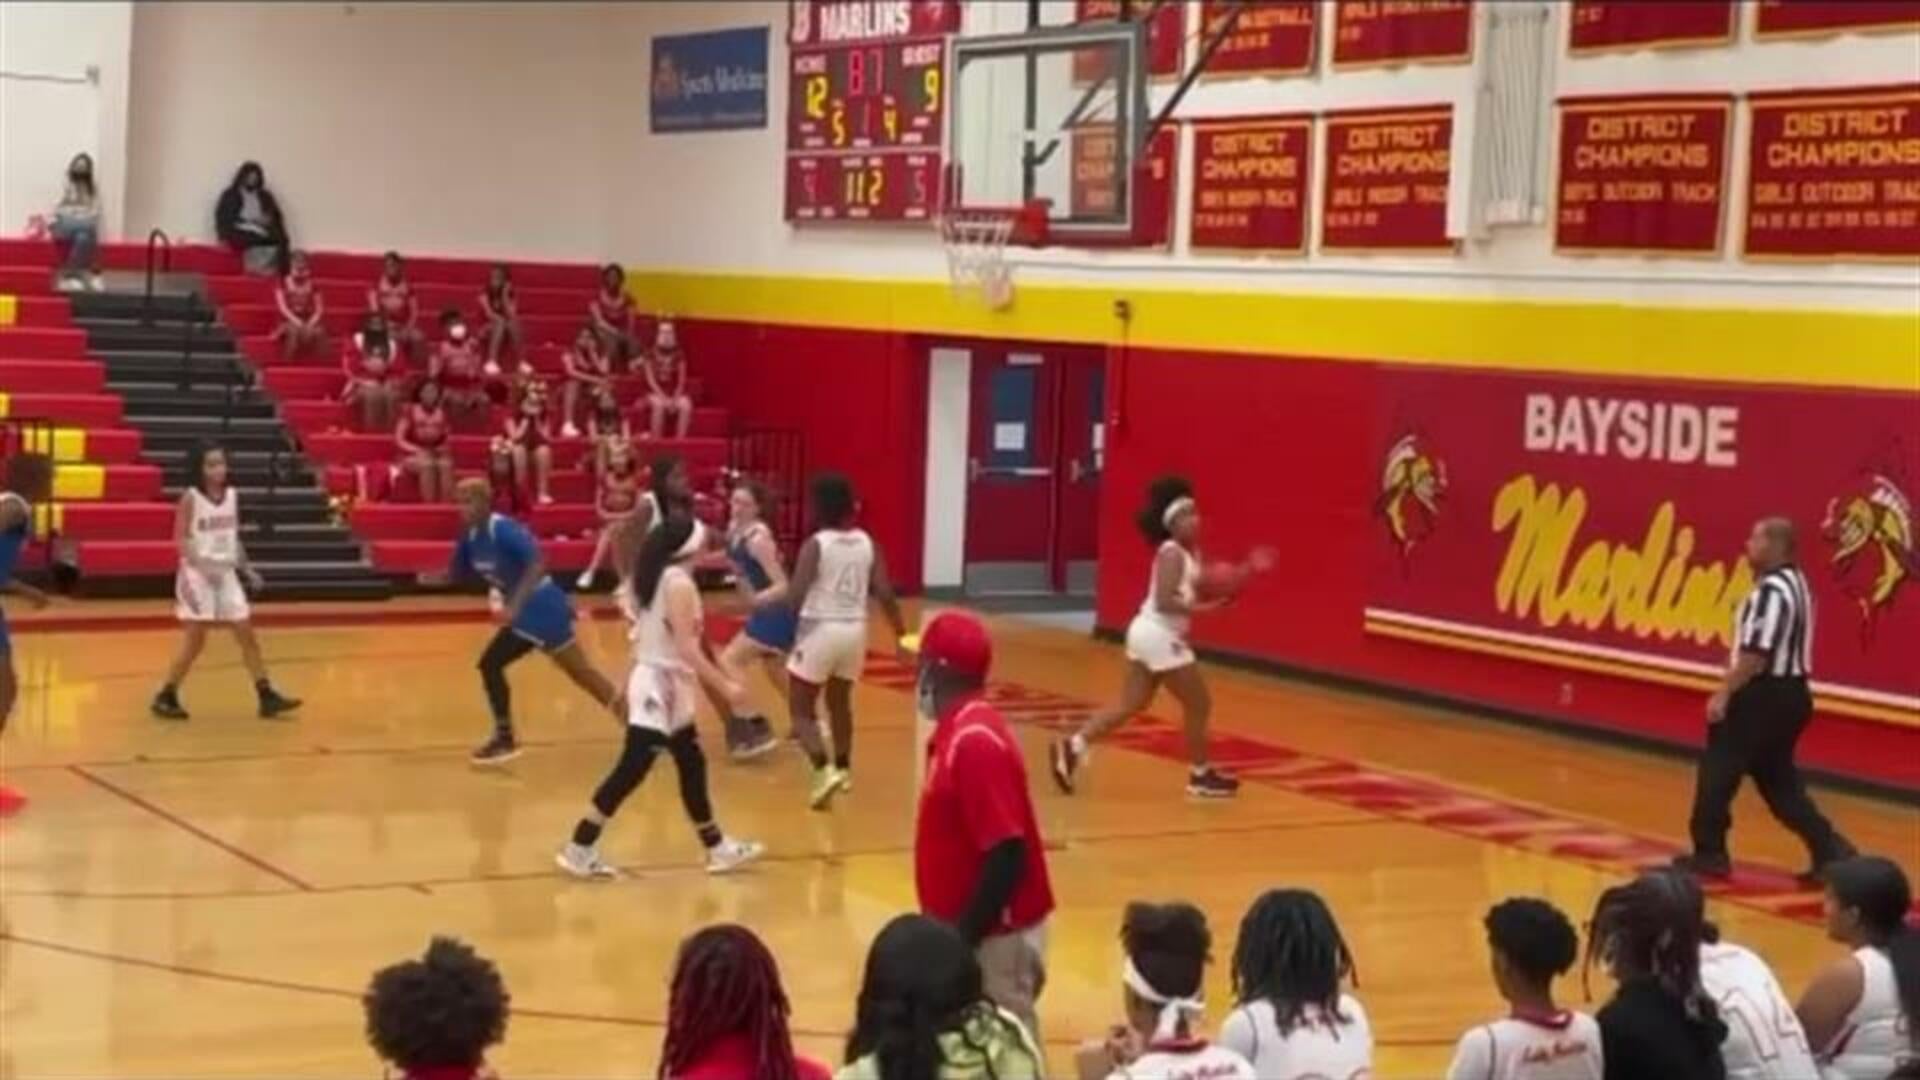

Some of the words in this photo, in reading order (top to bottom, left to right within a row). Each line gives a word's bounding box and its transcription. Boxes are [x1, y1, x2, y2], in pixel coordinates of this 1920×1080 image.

[806, 76, 828, 119] 12
[924, 69, 940, 113] 9
[831, 109, 846, 146] 5
[883, 109, 897, 141] 4
[1587, 114, 1697, 139] DISTRICT
[1784, 108, 1908, 137] DISTRICT
[1212, 132, 1287, 155] DISTRICT
[1347, 126, 1439, 150] DISTRICT
[1203, 156, 1297, 180] CHAMPIONS
[1338, 150, 1449, 175] CHAMPIONS
[1575, 143, 1708, 169] CHAMPIONS
[1768, 139, 1920, 168] CHAMPIONS
[1524, 394, 1738, 467] BAYSIDE
[833, 561, 864, 608] 4
